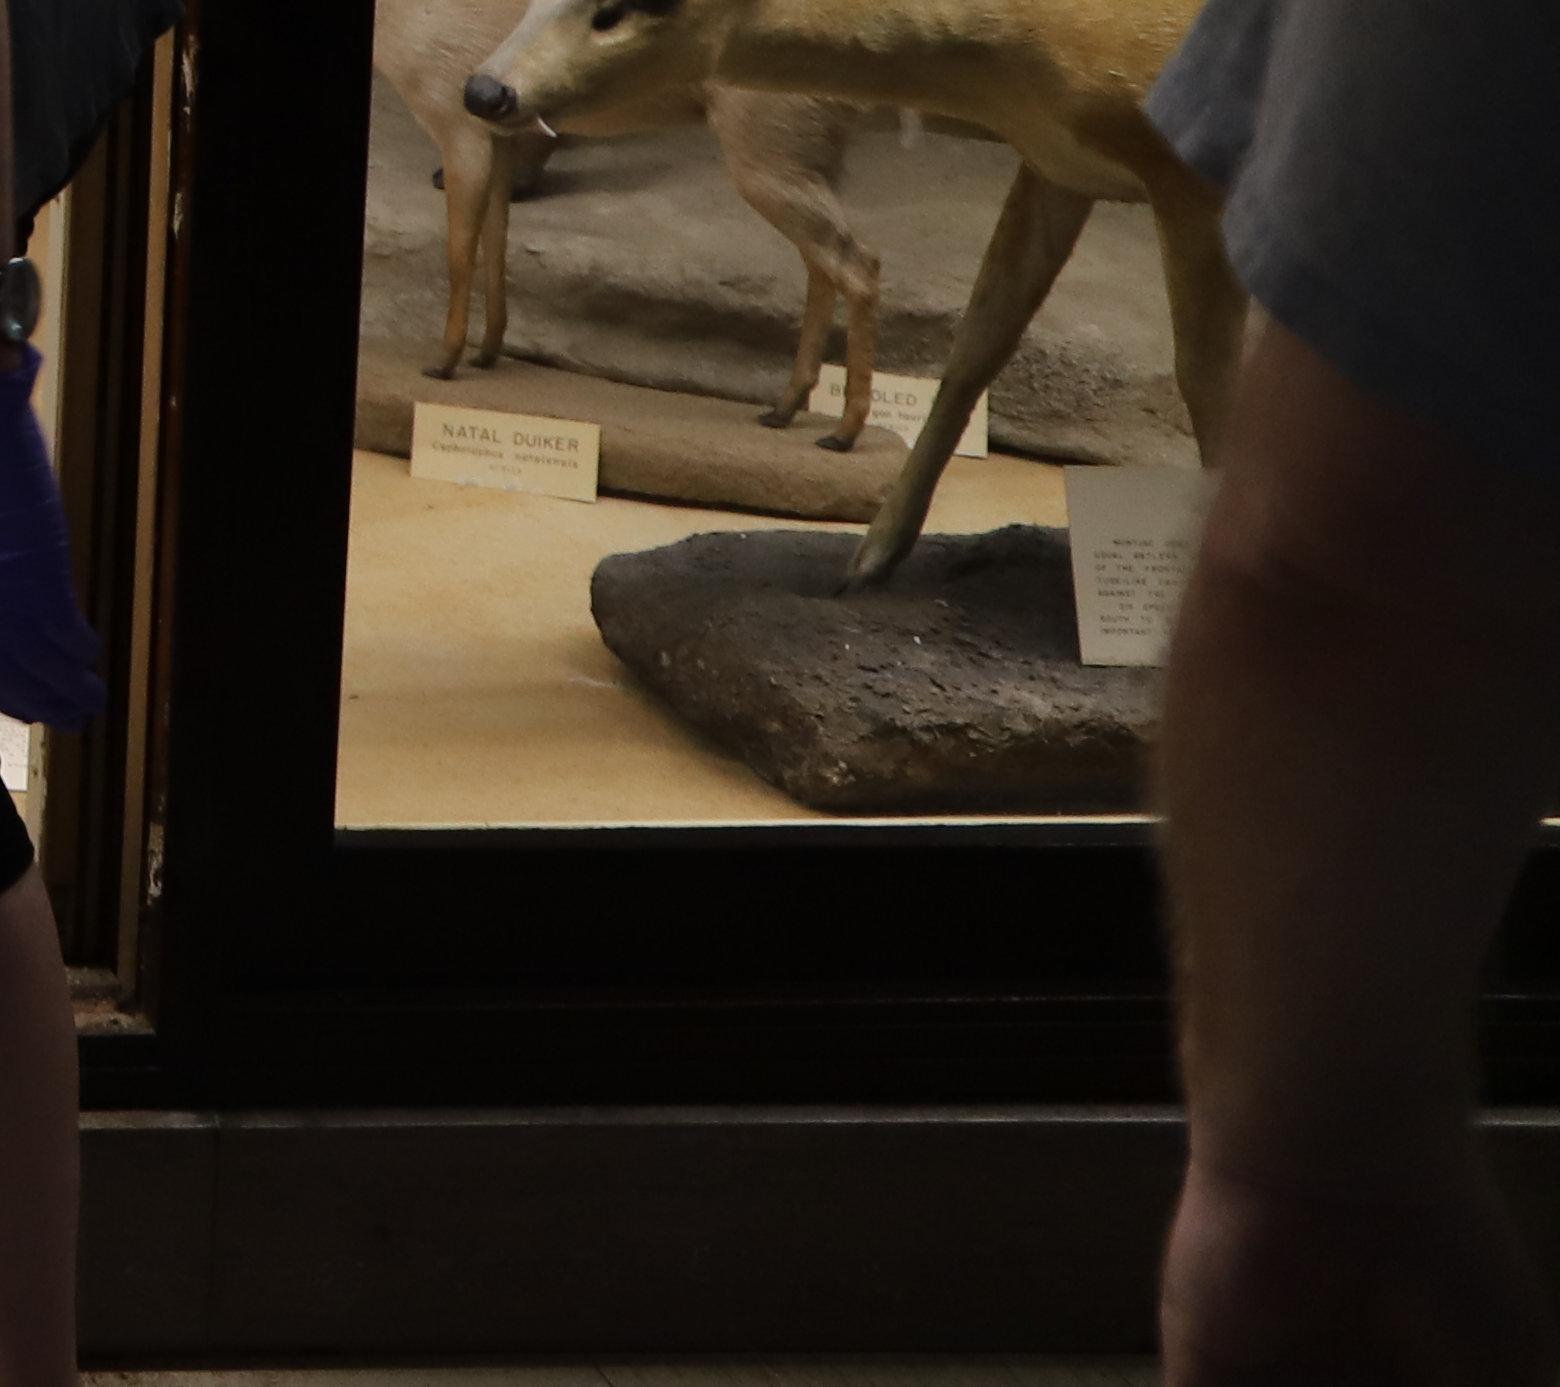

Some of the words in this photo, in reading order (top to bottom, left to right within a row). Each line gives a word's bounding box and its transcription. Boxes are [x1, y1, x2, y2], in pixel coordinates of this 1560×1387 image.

[829, 383, 918, 406] BDLED
[442, 423, 502, 443] NATAL
[513, 431, 580, 453] DUIKER
